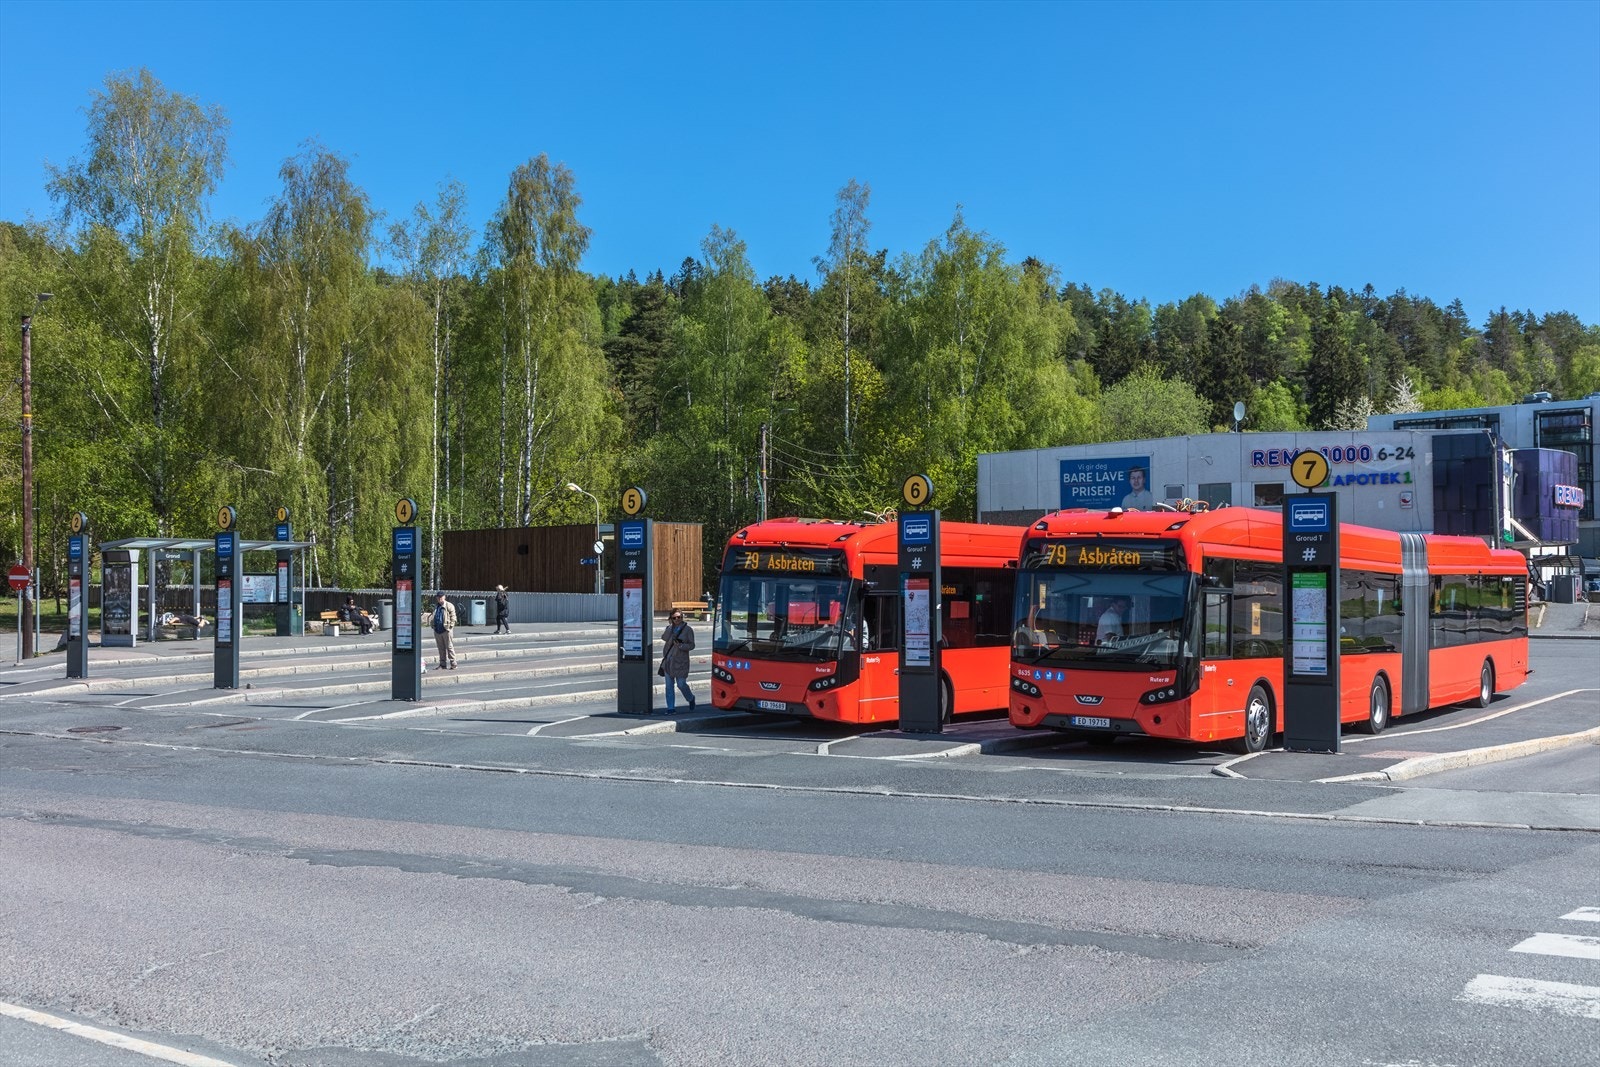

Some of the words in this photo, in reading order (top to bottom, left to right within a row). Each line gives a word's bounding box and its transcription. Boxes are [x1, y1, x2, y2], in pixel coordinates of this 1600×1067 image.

[1251, 447, 1302, 467] REM
[1378, 447, 1415, 461] 6-24
[1302, 460, 1317, 480] 7
[1063, 472, 1093, 483] BARE
[1095, 471, 1125, 482] LAVE
[1333, 472, 1401, 487] APOTEK
[1403, 471, 1413, 484] 1
[910, 482, 921, 499] 6
[1072, 485, 1116, 496] PRISER!
[627, 494, 636, 509] 5
[279, 510, 284, 518] 1
[400, 504, 407, 517] 4
[74, 517, 79, 528] 2
[222, 512, 228, 524] 3
[744, 551, 760, 570] 79
[1047, 544, 1067, 565] 79
[1017, 669, 1031, 677] 8635
[761, 700, 769, 708] ED
[1078, 695, 1099, 703] VDL
[1077, 717, 1087, 725] ED
[1088, 718, 1108, 727] 19715
